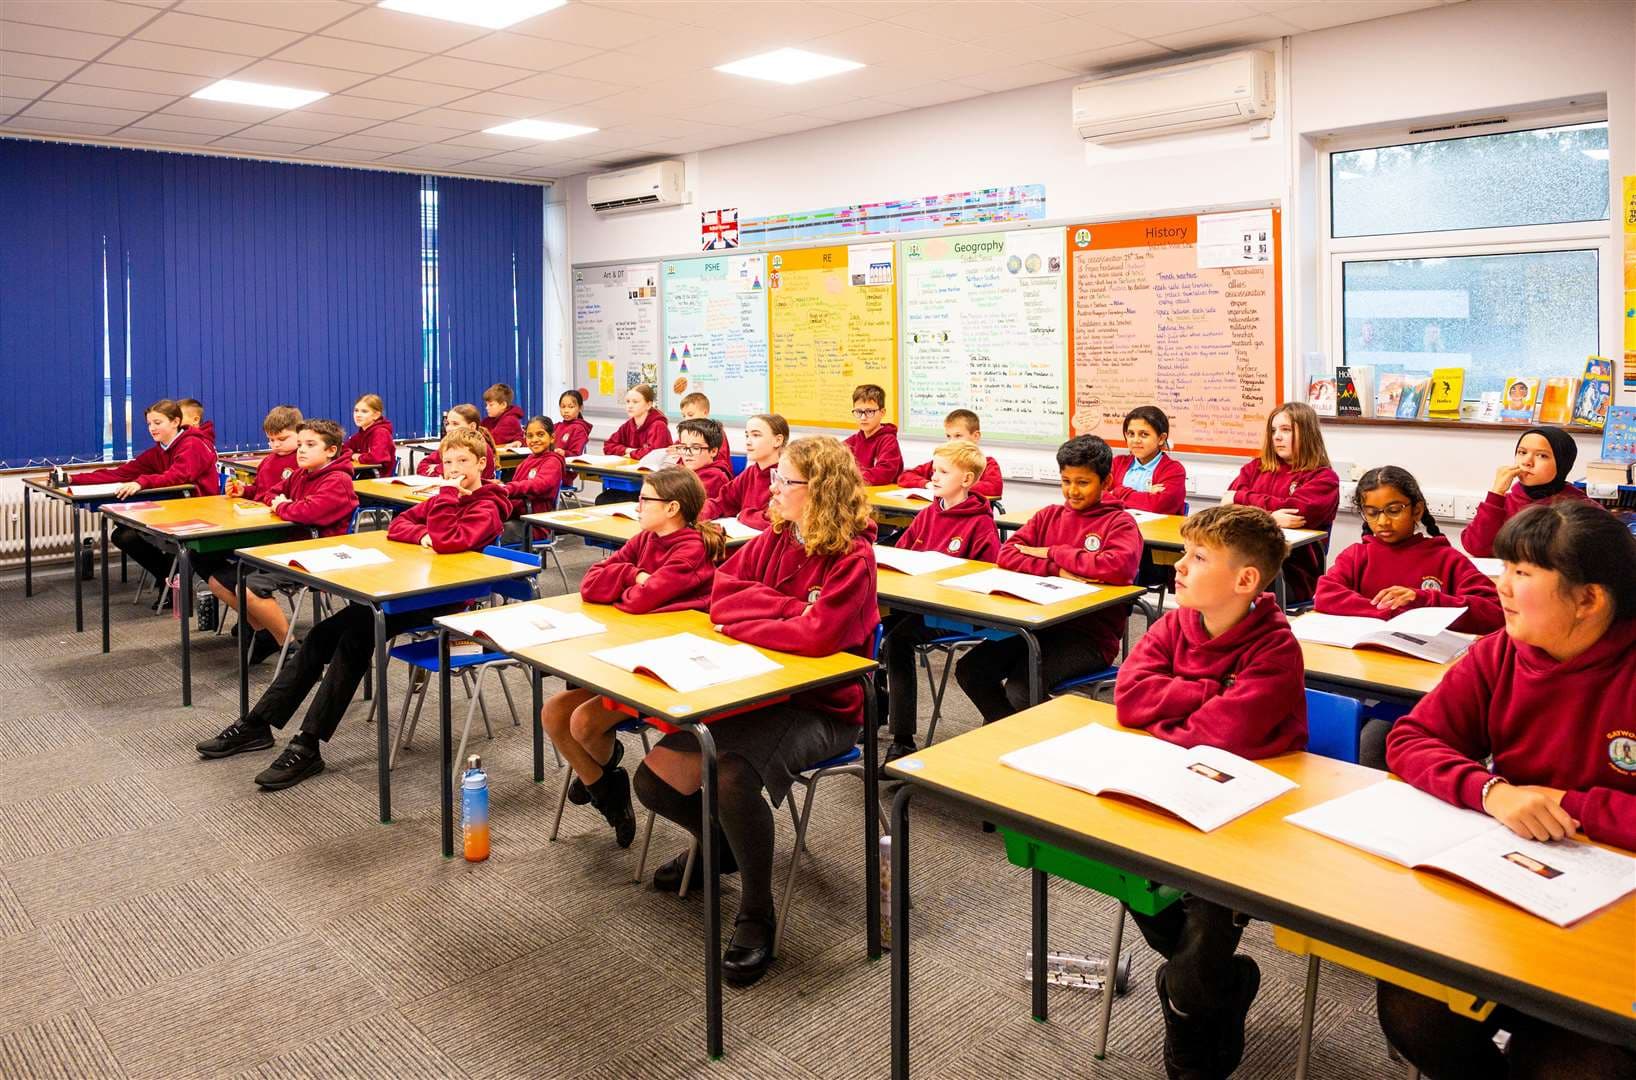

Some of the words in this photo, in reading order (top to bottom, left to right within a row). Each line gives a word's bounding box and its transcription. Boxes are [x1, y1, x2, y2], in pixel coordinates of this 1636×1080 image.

[1146, 226, 1188, 240] History
[954, 240, 1004, 256] Geography
[823, 254, 832, 262] RE
[705, 262, 720, 272] PSHE
[618, 270, 624, 278] DT
